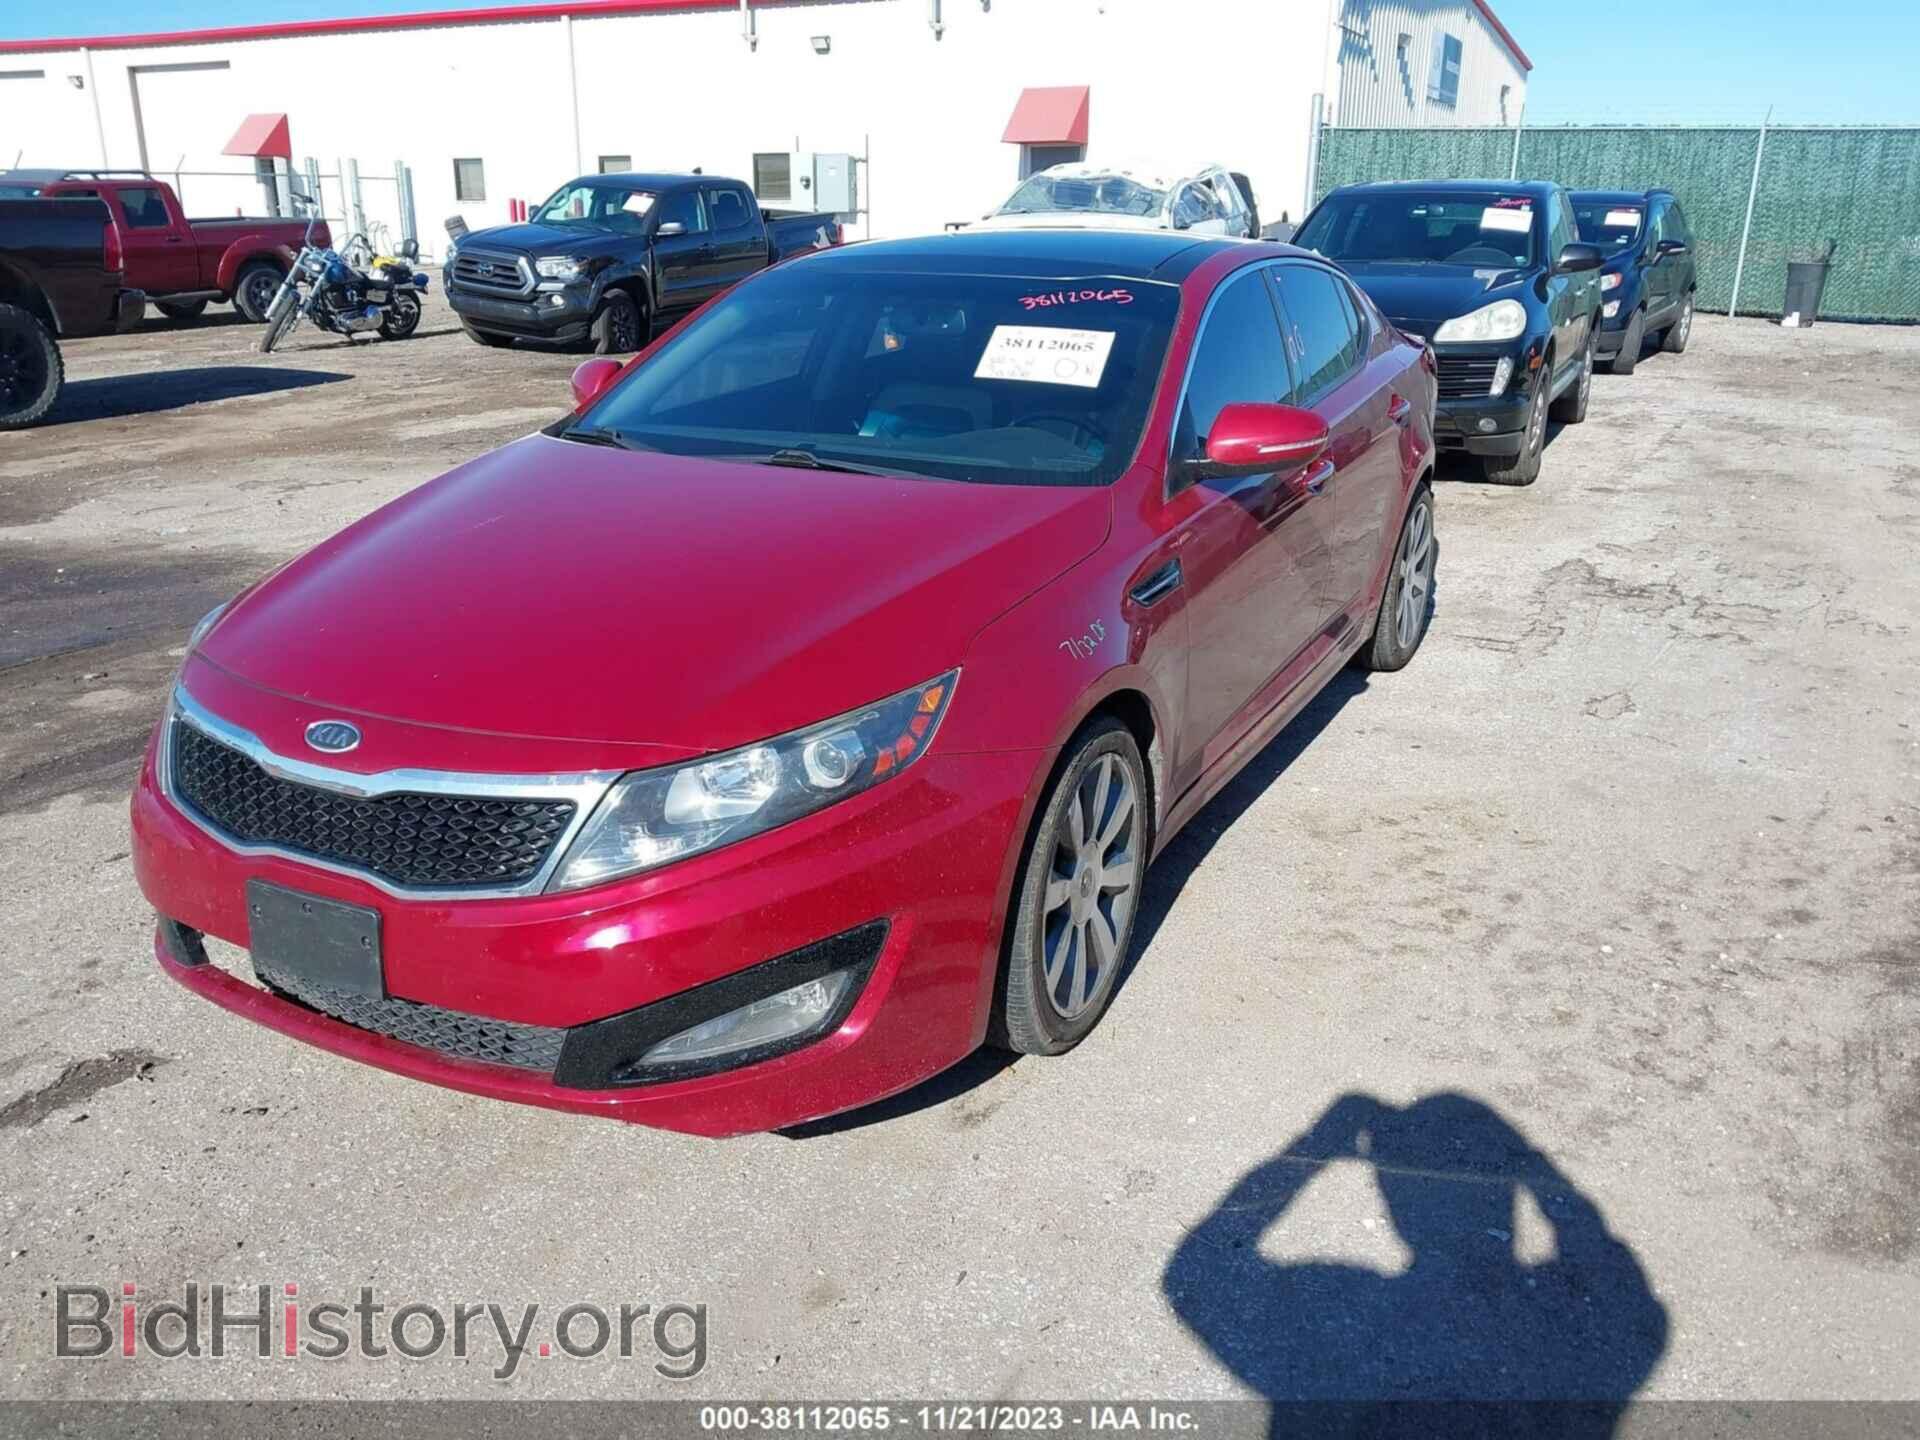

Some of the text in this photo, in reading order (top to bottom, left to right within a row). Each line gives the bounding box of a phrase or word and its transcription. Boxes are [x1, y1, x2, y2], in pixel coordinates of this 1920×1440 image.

[1018, 289, 1135, 310] 38112065
[1000, 337, 1096, 353] 38112065
[311, 724, 352, 748] KIA
